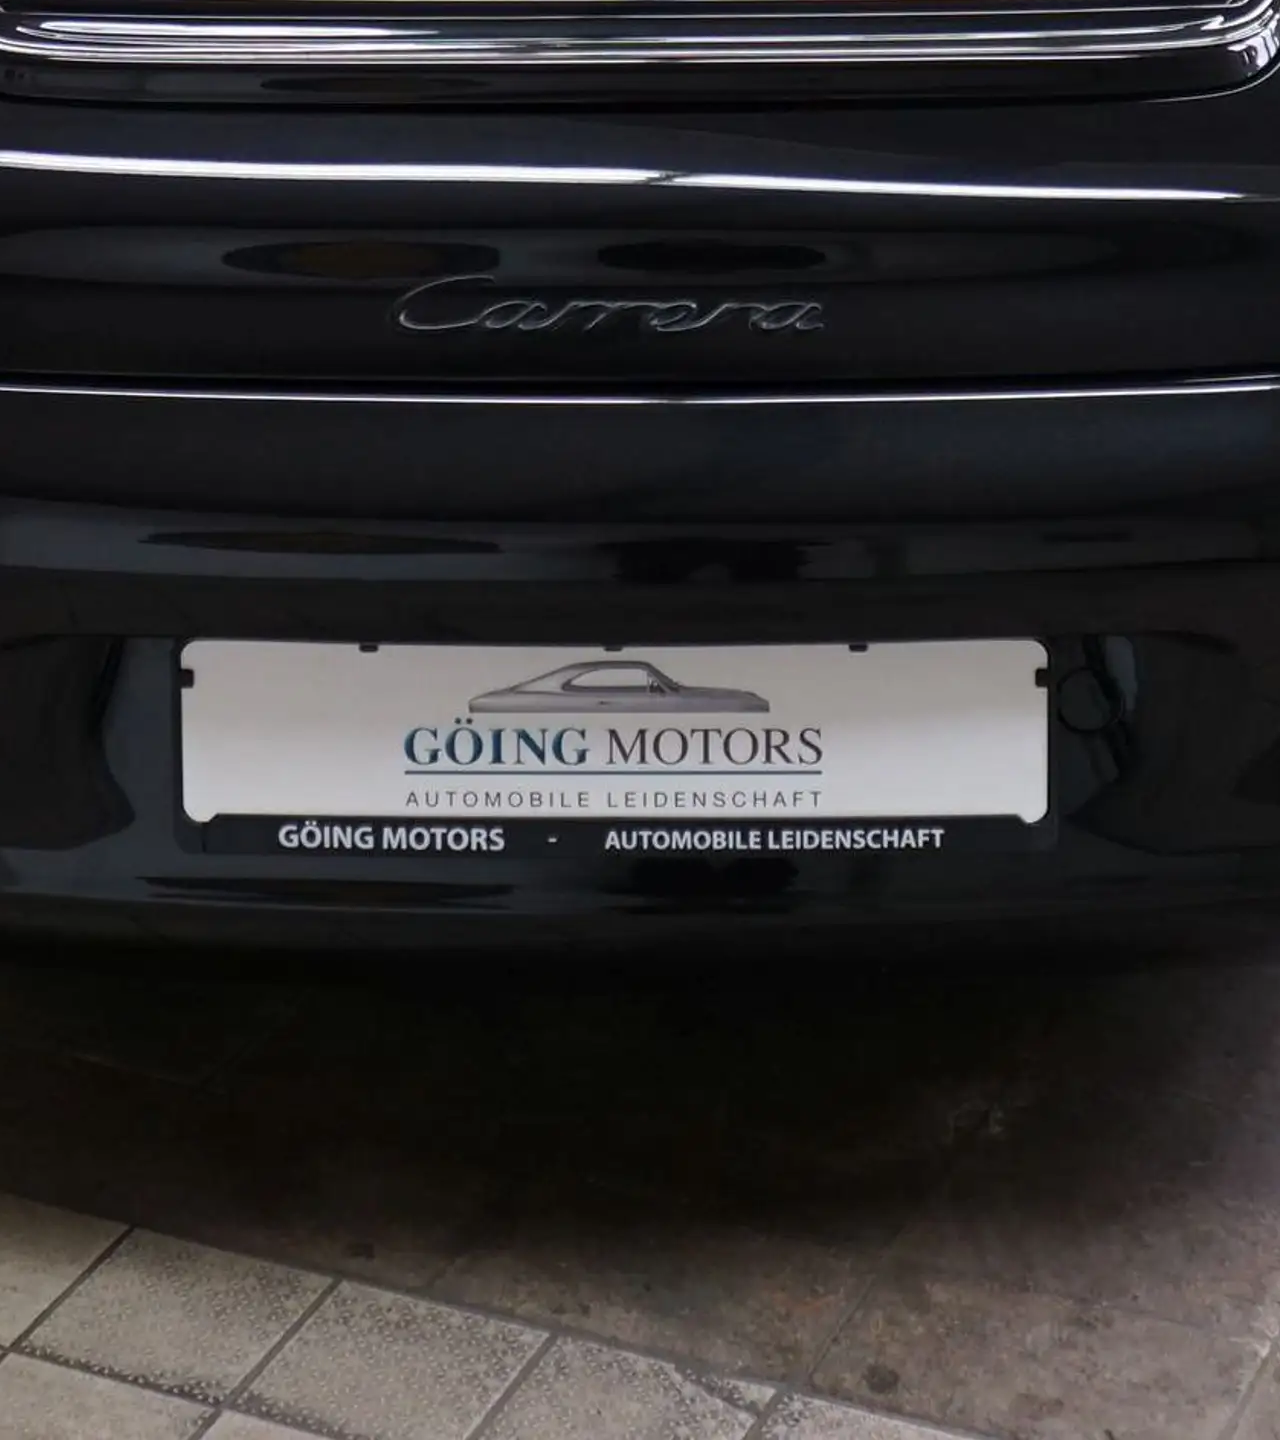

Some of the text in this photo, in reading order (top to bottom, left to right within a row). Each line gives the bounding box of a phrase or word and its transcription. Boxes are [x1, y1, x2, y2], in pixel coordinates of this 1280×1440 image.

[394, 274, 825, 332] Carrera
[404, 716, 824, 766] GÖING MOTORS
[405, 791, 824, 809] AUTOMOBILE LEIDENSCHAFT
[277, 820, 374, 849] GÖING
[382, 826, 506, 851] MOTORS
[604, 830, 762, 851] AUTOMOBILE
[767, 828, 945, 850] LEIDENSCHAFT
